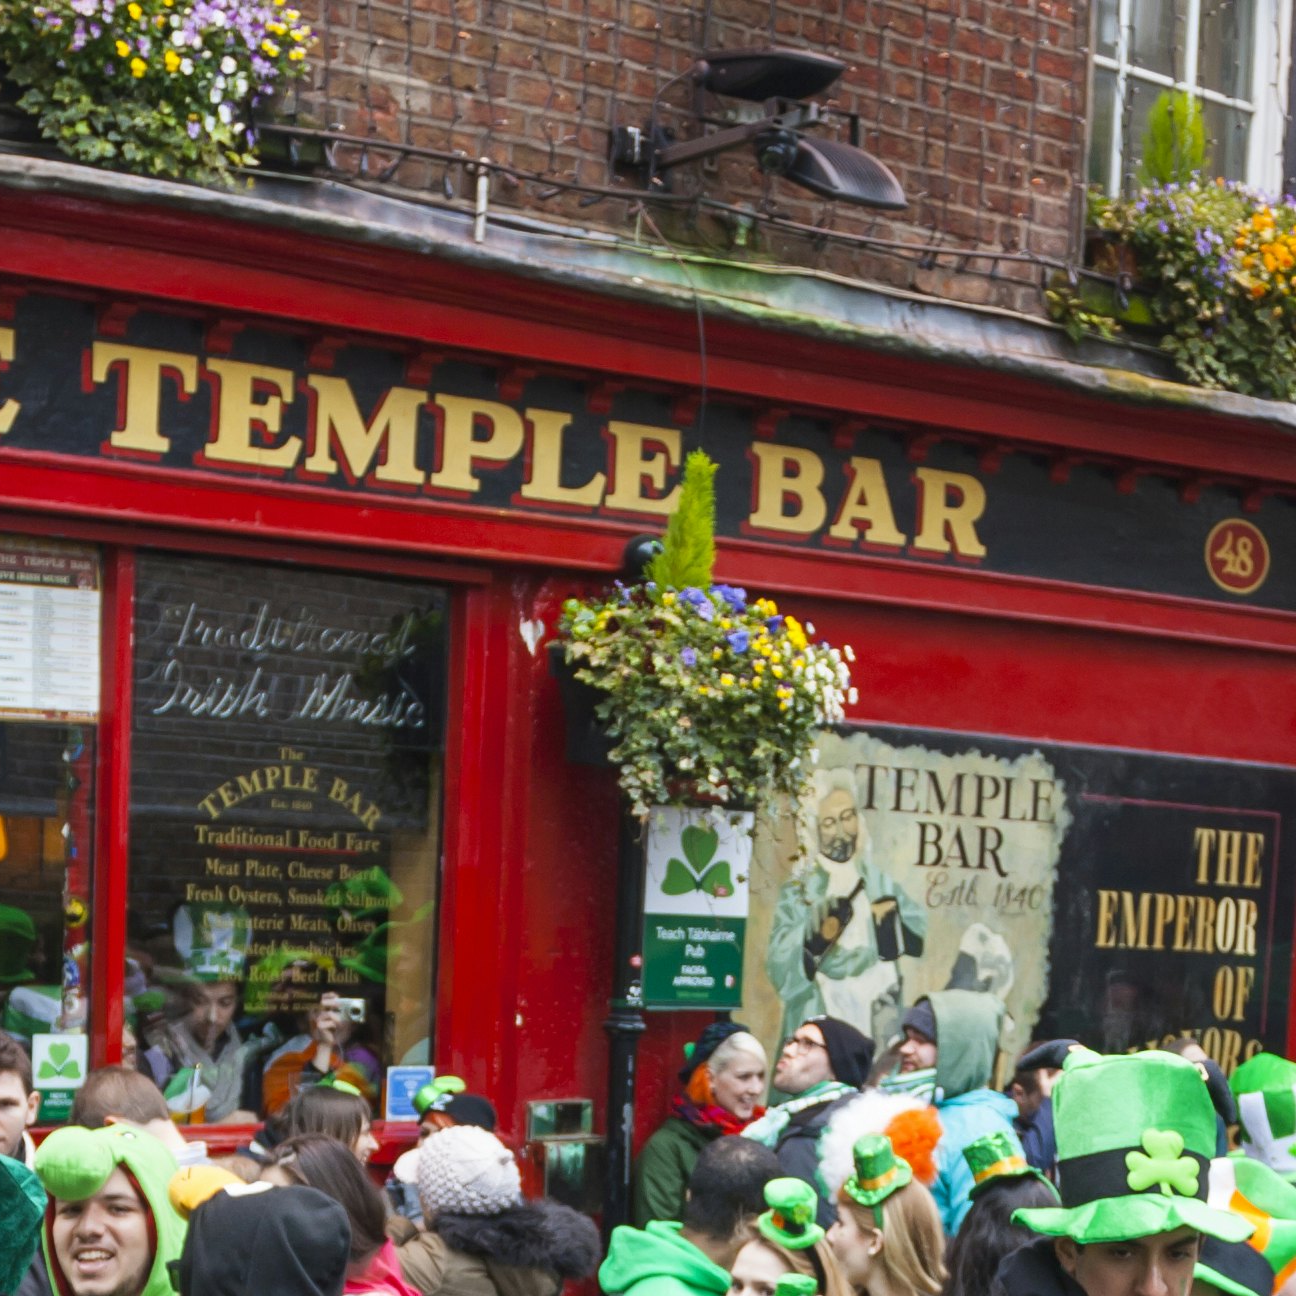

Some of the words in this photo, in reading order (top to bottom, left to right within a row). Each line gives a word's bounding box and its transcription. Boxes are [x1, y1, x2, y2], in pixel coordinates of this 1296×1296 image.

[92, 340, 685, 518] TEMPLE
[749, 440, 987, 560] BAR
[1215, 530, 1253, 576] 48
[279, 747, 304, 761] The
[198, 765, 320, 820] TEMPLE
[328, 776, 383, 831] BAR
[855, 763, 1055, 825] TEMPLE
[195, 825, 290, 847] Traditional
[298, 830, 338, 849] Food
[346, 833, 380, 852] Fare
[915, 822, 1008, 878] BAR
[1194, 827, 1265, 889] THE
[206, 858, 240, 877] Meat
[245, 859, 283, 880] Plate,
[288, 862, 333, 878] Cheese
[186, 884, 223, 902] Fresh
[228, 885, 282, 907] Oysters,
[288, 888, 340, 906] Smoked
[290, 914, 331, 932] Meats,
[1096, 890, 1257, 957] EMPEROR
[685, 943, 705, 958] Pub
[327, 967, 359, 985] Rolls
[1213, 965, 1255, 1021] OF
